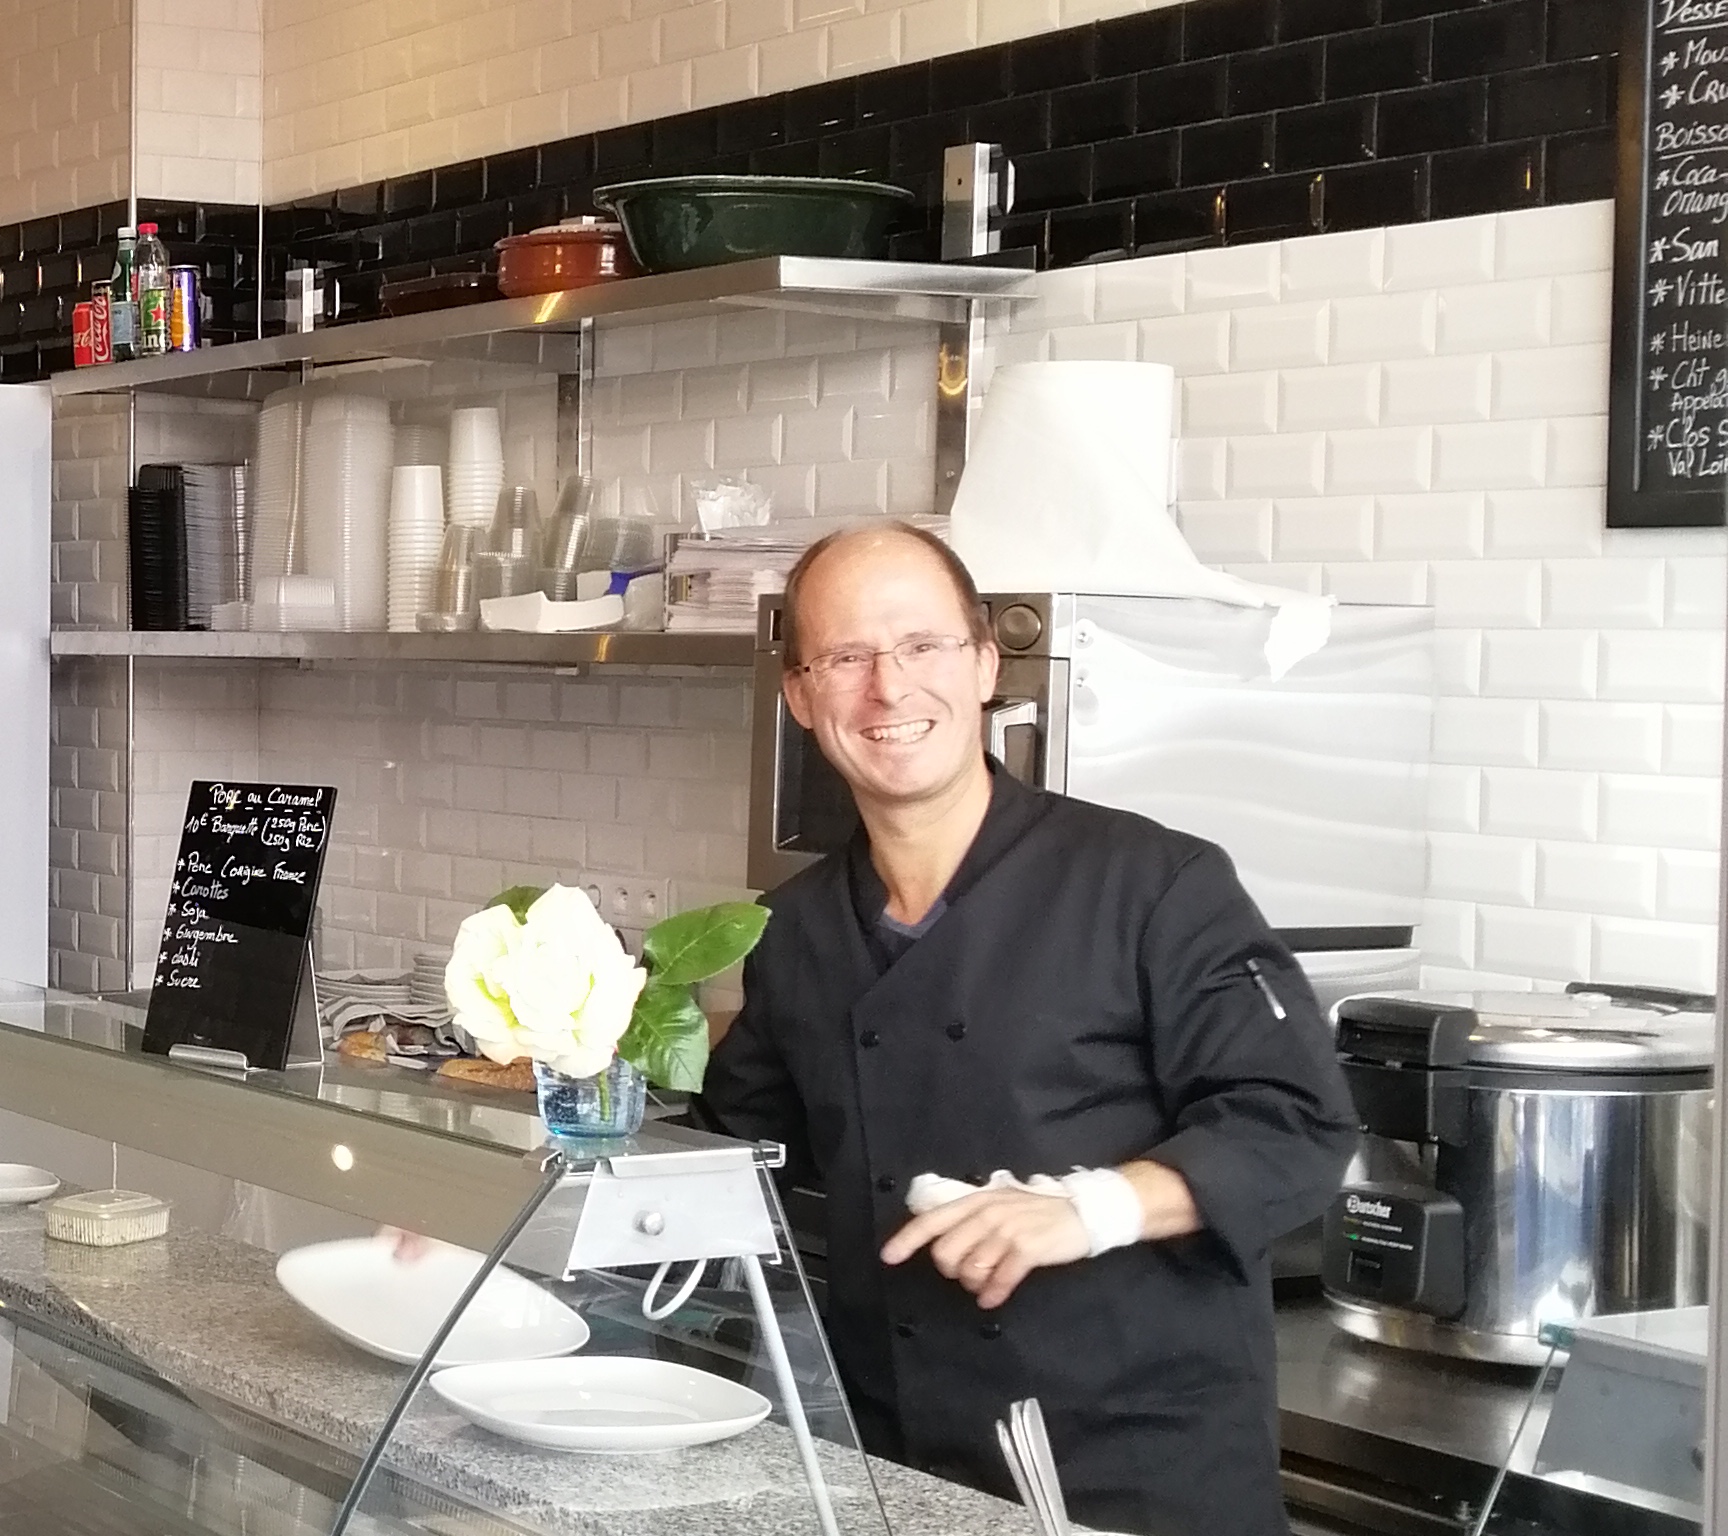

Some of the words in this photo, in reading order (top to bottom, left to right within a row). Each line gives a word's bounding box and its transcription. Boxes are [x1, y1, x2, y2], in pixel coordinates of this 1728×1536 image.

[1670, 226, 1720, 262] San
[247, 792, 263, 805] au
[267, 786, 323, 807] Caramel
[188, 851, 212, 874] Porc
[181, 900, 210, 925] Soja
[176, 923, 239, 950] Gingembre
[166, 968, 202, 988] Sucre
